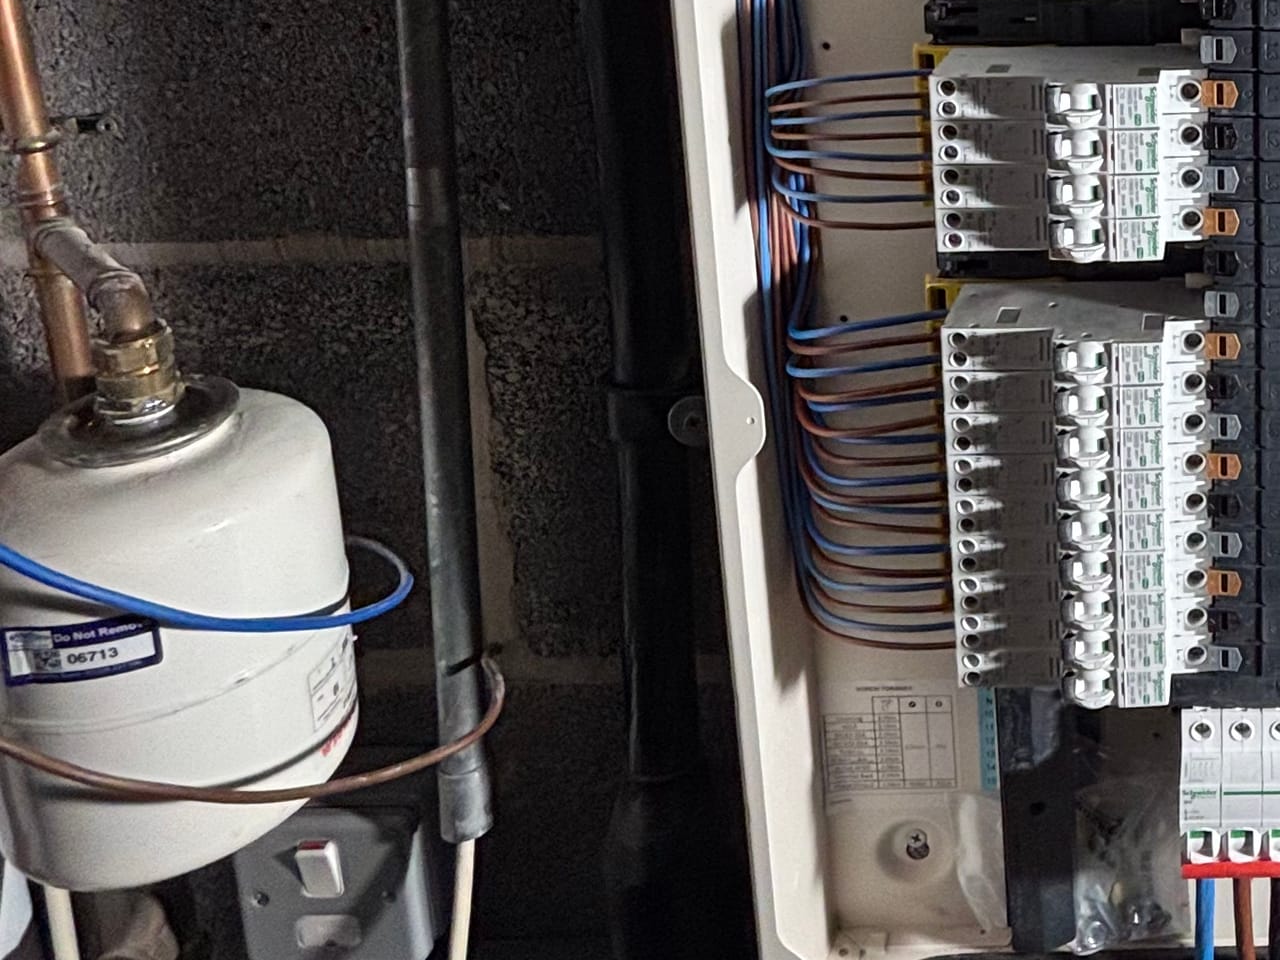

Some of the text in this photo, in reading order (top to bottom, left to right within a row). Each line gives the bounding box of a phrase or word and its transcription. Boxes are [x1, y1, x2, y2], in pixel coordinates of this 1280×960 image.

[53, 633, 71, 643] Do
[73, 629, 96, 640] Not
[67, 647, 119, 665] 06713
